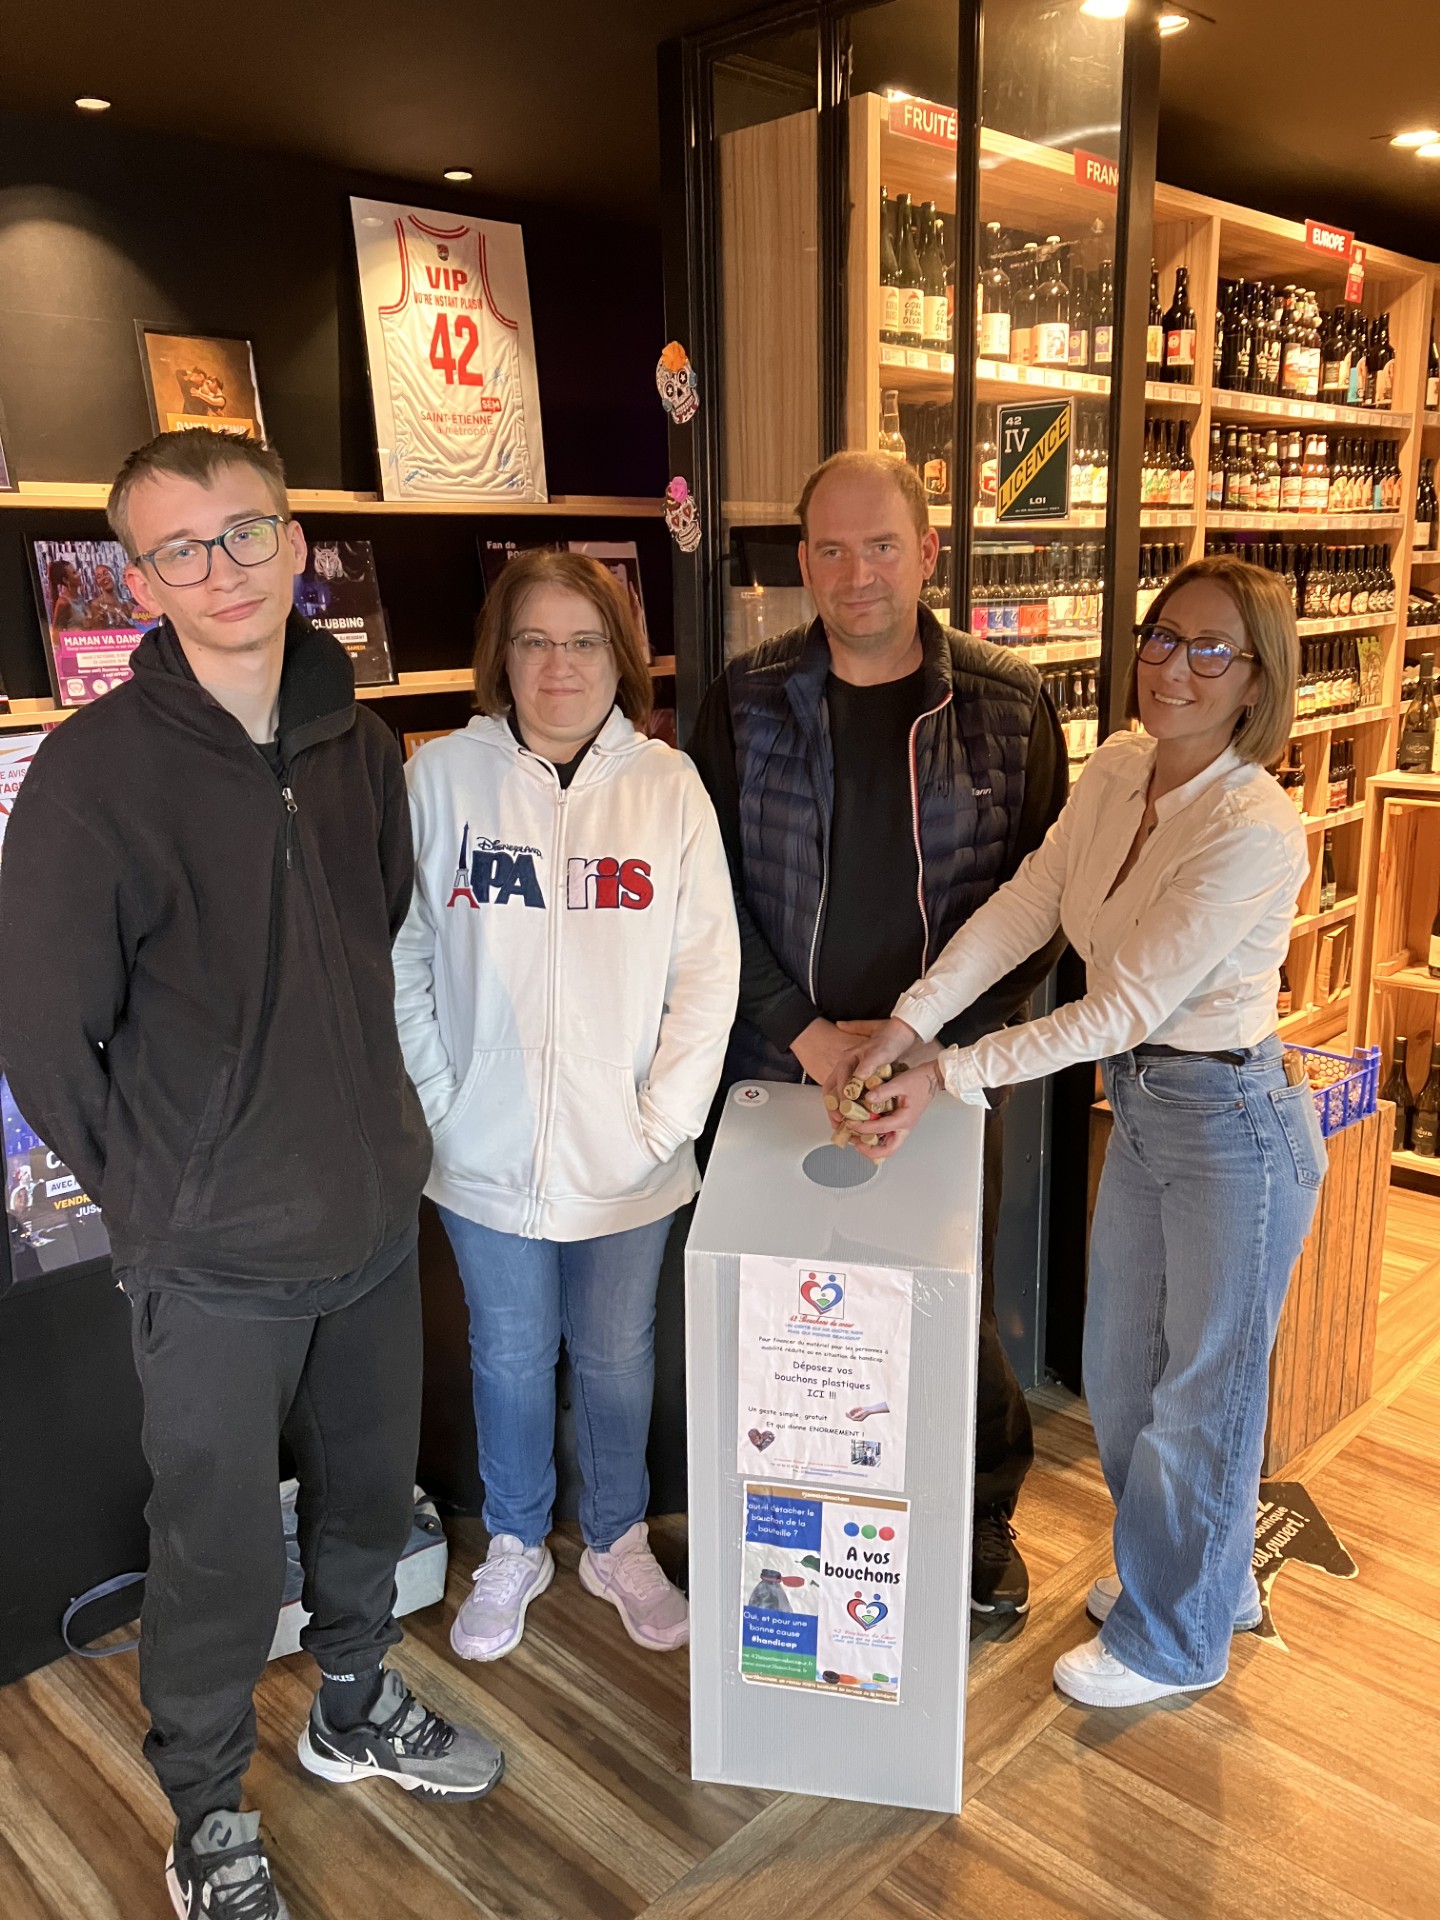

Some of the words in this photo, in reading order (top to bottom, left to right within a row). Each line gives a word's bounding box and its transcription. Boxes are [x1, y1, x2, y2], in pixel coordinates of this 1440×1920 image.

[905, 105, 958, 140] FRUITÉ
[1312, 227, 1346, 252] EUROPE
[425, 265, 468, 291] VIP
[429, 313, 484, 387] 42
[1005, 416, 1022, 425] 42
[1004, 428, 1030, 453] IV
[1000, 411, 1068, 512] LICENCE
[1029, 496, 1046, 504] LOI
[486, 541, 502, 549] Fan
[505, 540, 516, 549] de
[312, 617, 364, 630] CLUBBING
[64, 636, 100, 646] MAMAN
[102, 635, 116, 644] VA
[0, 771, 6, 779] E
[51, 1179, 72, 1191] AVEC
[54, 1194, 92, 1210] VENDR
[824, 1351, 848, 1359] situation
[859, 1355, 883, 1363] handicap
[793, 1360, 833, 1373] Déposez
[836, 1367, 853, 1375] vos
[774, 1372, 818, 1384] bouchons
[822, 1378, 871, 1390] plastiques
[807, 1389, 825, 1398] ICI
[829, 1391, 837, 1400] !!!
[779, 1411, 801, 1419] simple,
[809, 1426, 859, 1437] ENORMEMENT
[751, 1514, 784, 1525] bouchon
[786, 1518, 796, 1526] de
[798, 1519, 806, 1527] la
[758, 1524, 792, 1537] bouteille
[846, 1546, 858, 1561] A
[863, 1551, 890, 1565] vos
[824, 1562, 901, 1584] bouchons
[744, 1611, 760, 1621] Oui,
[749, 1623, 774, 1634] bonne
[776, 1629, 800, 1637] cause
[751, 1635, 798, 1649] #handicap
